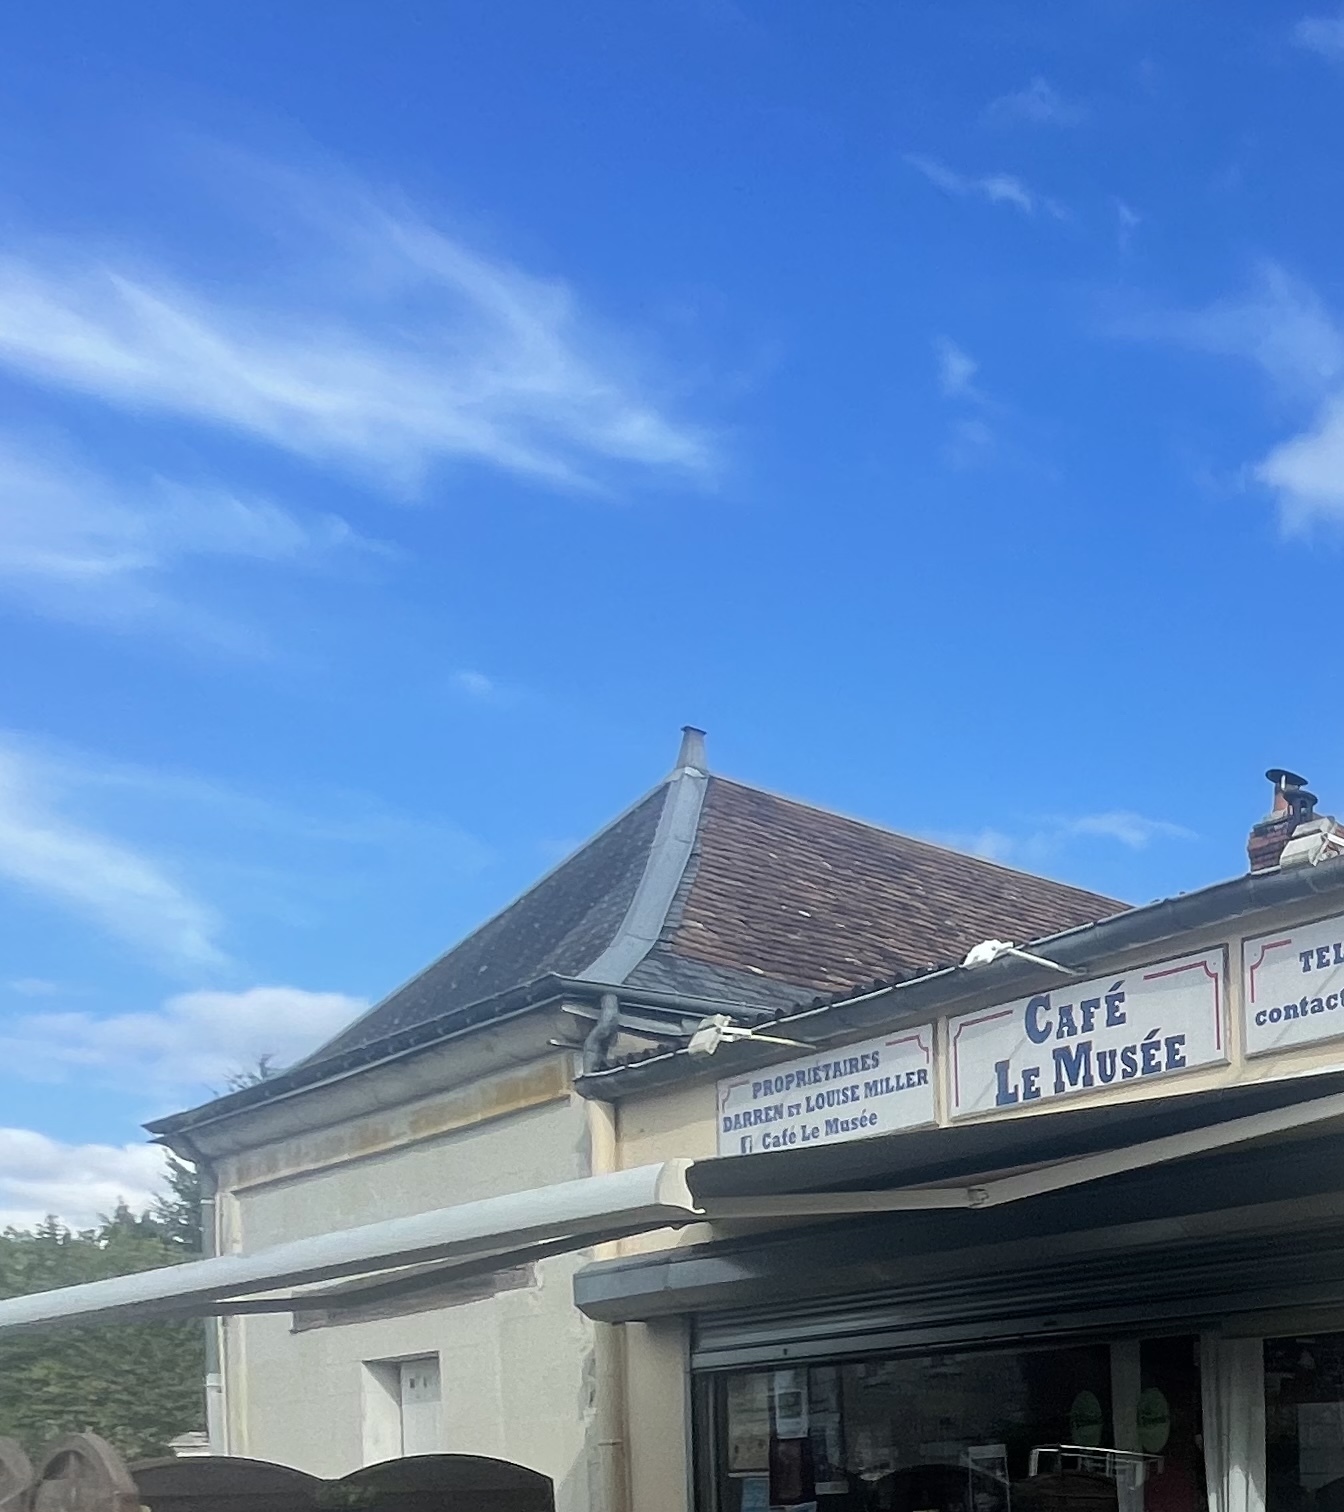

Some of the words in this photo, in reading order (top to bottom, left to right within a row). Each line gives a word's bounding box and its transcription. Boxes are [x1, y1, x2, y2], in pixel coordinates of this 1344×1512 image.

[1025, 980, 1127, 1044] CAFÉ
[995, 1059, 1041, 1106] LE
[1052, 1027, 1186, 1094] MUSÉE
[723, 1103, 784, 1133] DARREN
[805, 1085, 860, 1113] LOUISE
[864, 1069, 928, 1099] MILLER
[762, 1125, 797, 1150] Café
[801, 1125, 819, 1142] Le
[825, 1109, 878, 1136] Musée
